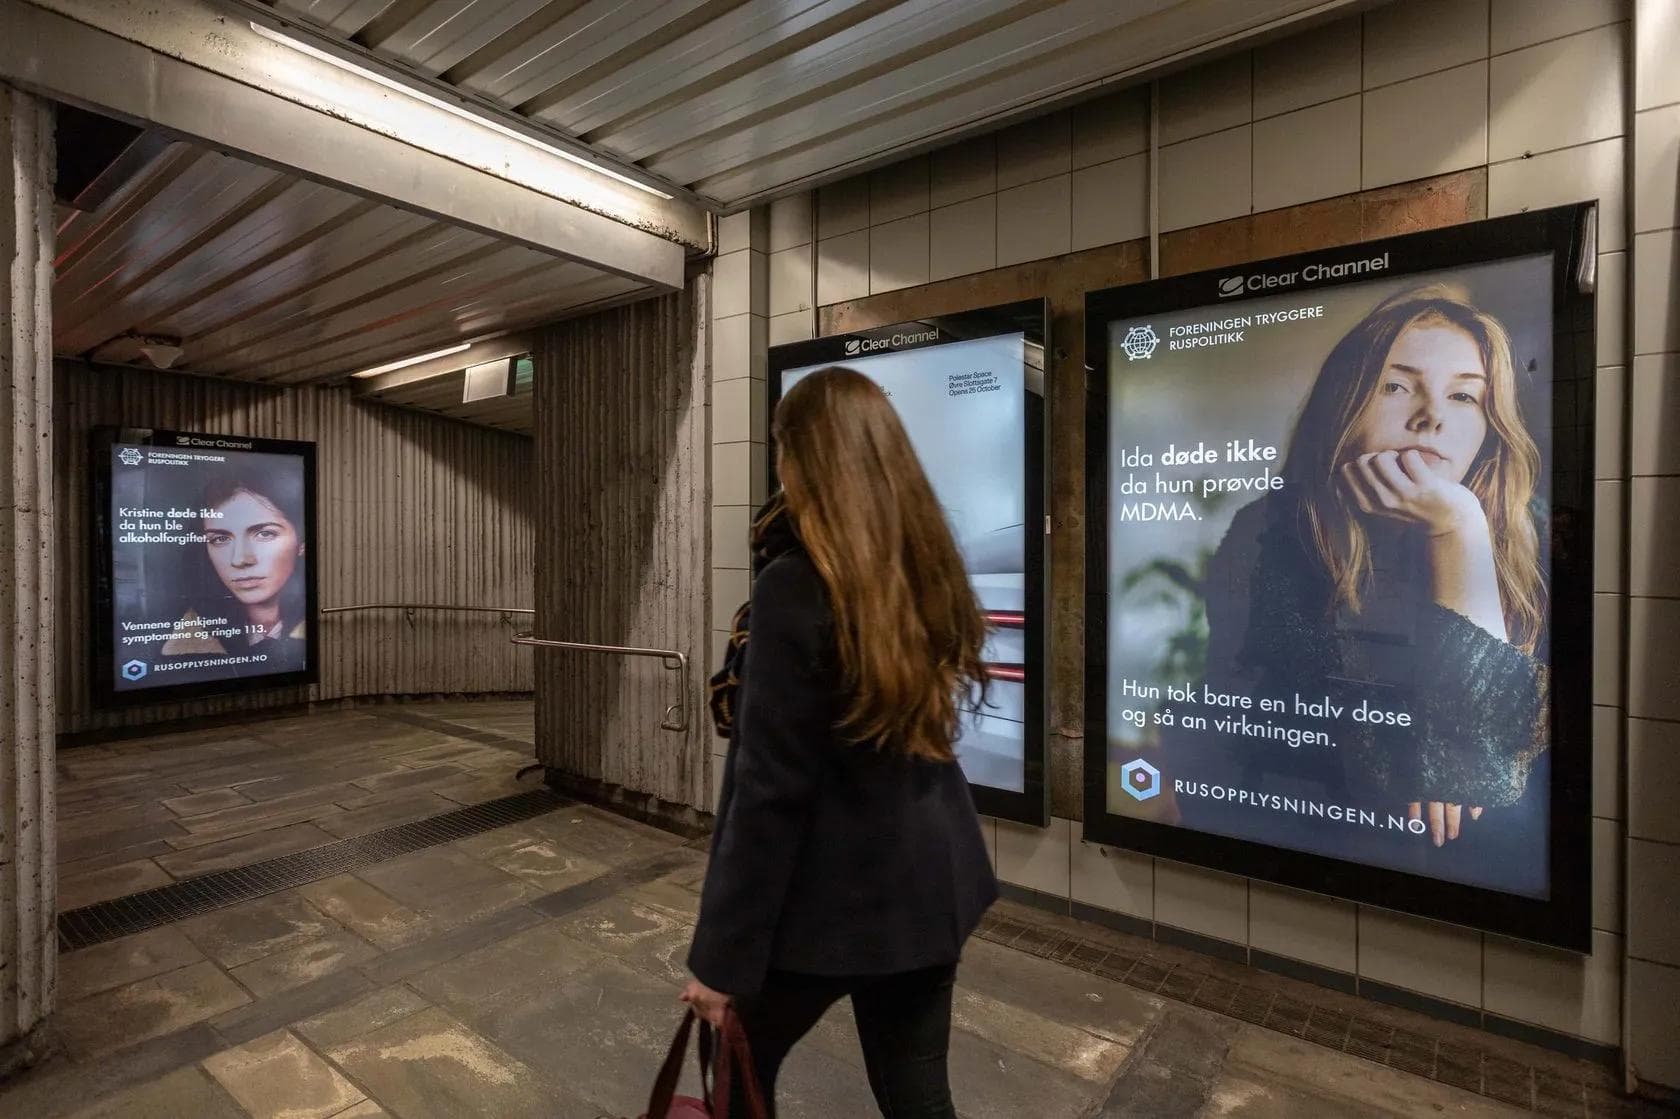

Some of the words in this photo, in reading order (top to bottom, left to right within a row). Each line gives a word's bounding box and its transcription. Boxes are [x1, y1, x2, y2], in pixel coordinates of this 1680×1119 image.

[1247, 270, 1299, 291] Clear
[1302, 252, 1389, 283] Channel
[1169, 316, 1251, 337] FORENINGEN
[1255, 306, 1324, 326] TRYGGERE
[861, 337, 890, 351] Clear
[892, 328, 939, 346] Channel
[1169, 331, 1244, 351] RUSPOLITIKK
[949, 373, 972, 381] Polestar
[973, 370, 992, 379] Space
[949, 381, 963, 389] Øvre
[949, 389, 968, 397] Opens
[977, 384, 1001, 393] October
[191, 438, 215, 446] Clear
[216, 439, 252, 449] Channel
[1121, 446, 1153, 468] Ida
[1161, 442, 1218, 466] døde
[1227, 439, 1277, 462] ikke
[1120, 473, 1147, 495] da
[1155, 471, 1194, 494] hun
[1203, 467, 1285, 498] prøvde
[119, 507, 164, 518] Kristine
[167, 508, 197, 519] døde
[200, 508, 224, 519] ikke
[1120, 502, 1202, 521] MDMA.
[119, 520, 136, 531] da
[139, 519, 161, 530] hun
[165, 520, 183, 531] ble
[119, 532, 210, 546] alkoholforgiftet.
[122, 620, 171, 631] Vennene
[173, 616, 228, 631] gjenkjente
[122, 630, 191, 645] symptomene
[194, 630, 209, 640] og
[211, 626, 241, 639] ringte
[244, 624, 267, 634] 113.
[154, 654, 268, 671] RUSOPPLYSNINGEN.NO
[1122, 679, 1160, 699] Hun
[1167, 682, 1197, 703] tok
[1204, 685, 1252, 709] bare
[1260, 698, 1286, 714] en
[1295, 693, 1344, 720] halv
[1352, 700, 1412, 727] dose
[1122, 708, 1146, 728] og
[1153, 705, 1174, 726] så
[1182, 714, 1207, 730] an
[1213, 715, 1337, 748] virkningen.
[1174, 779, 1426, 835] RUSOPPLYSNINGEN.NO
